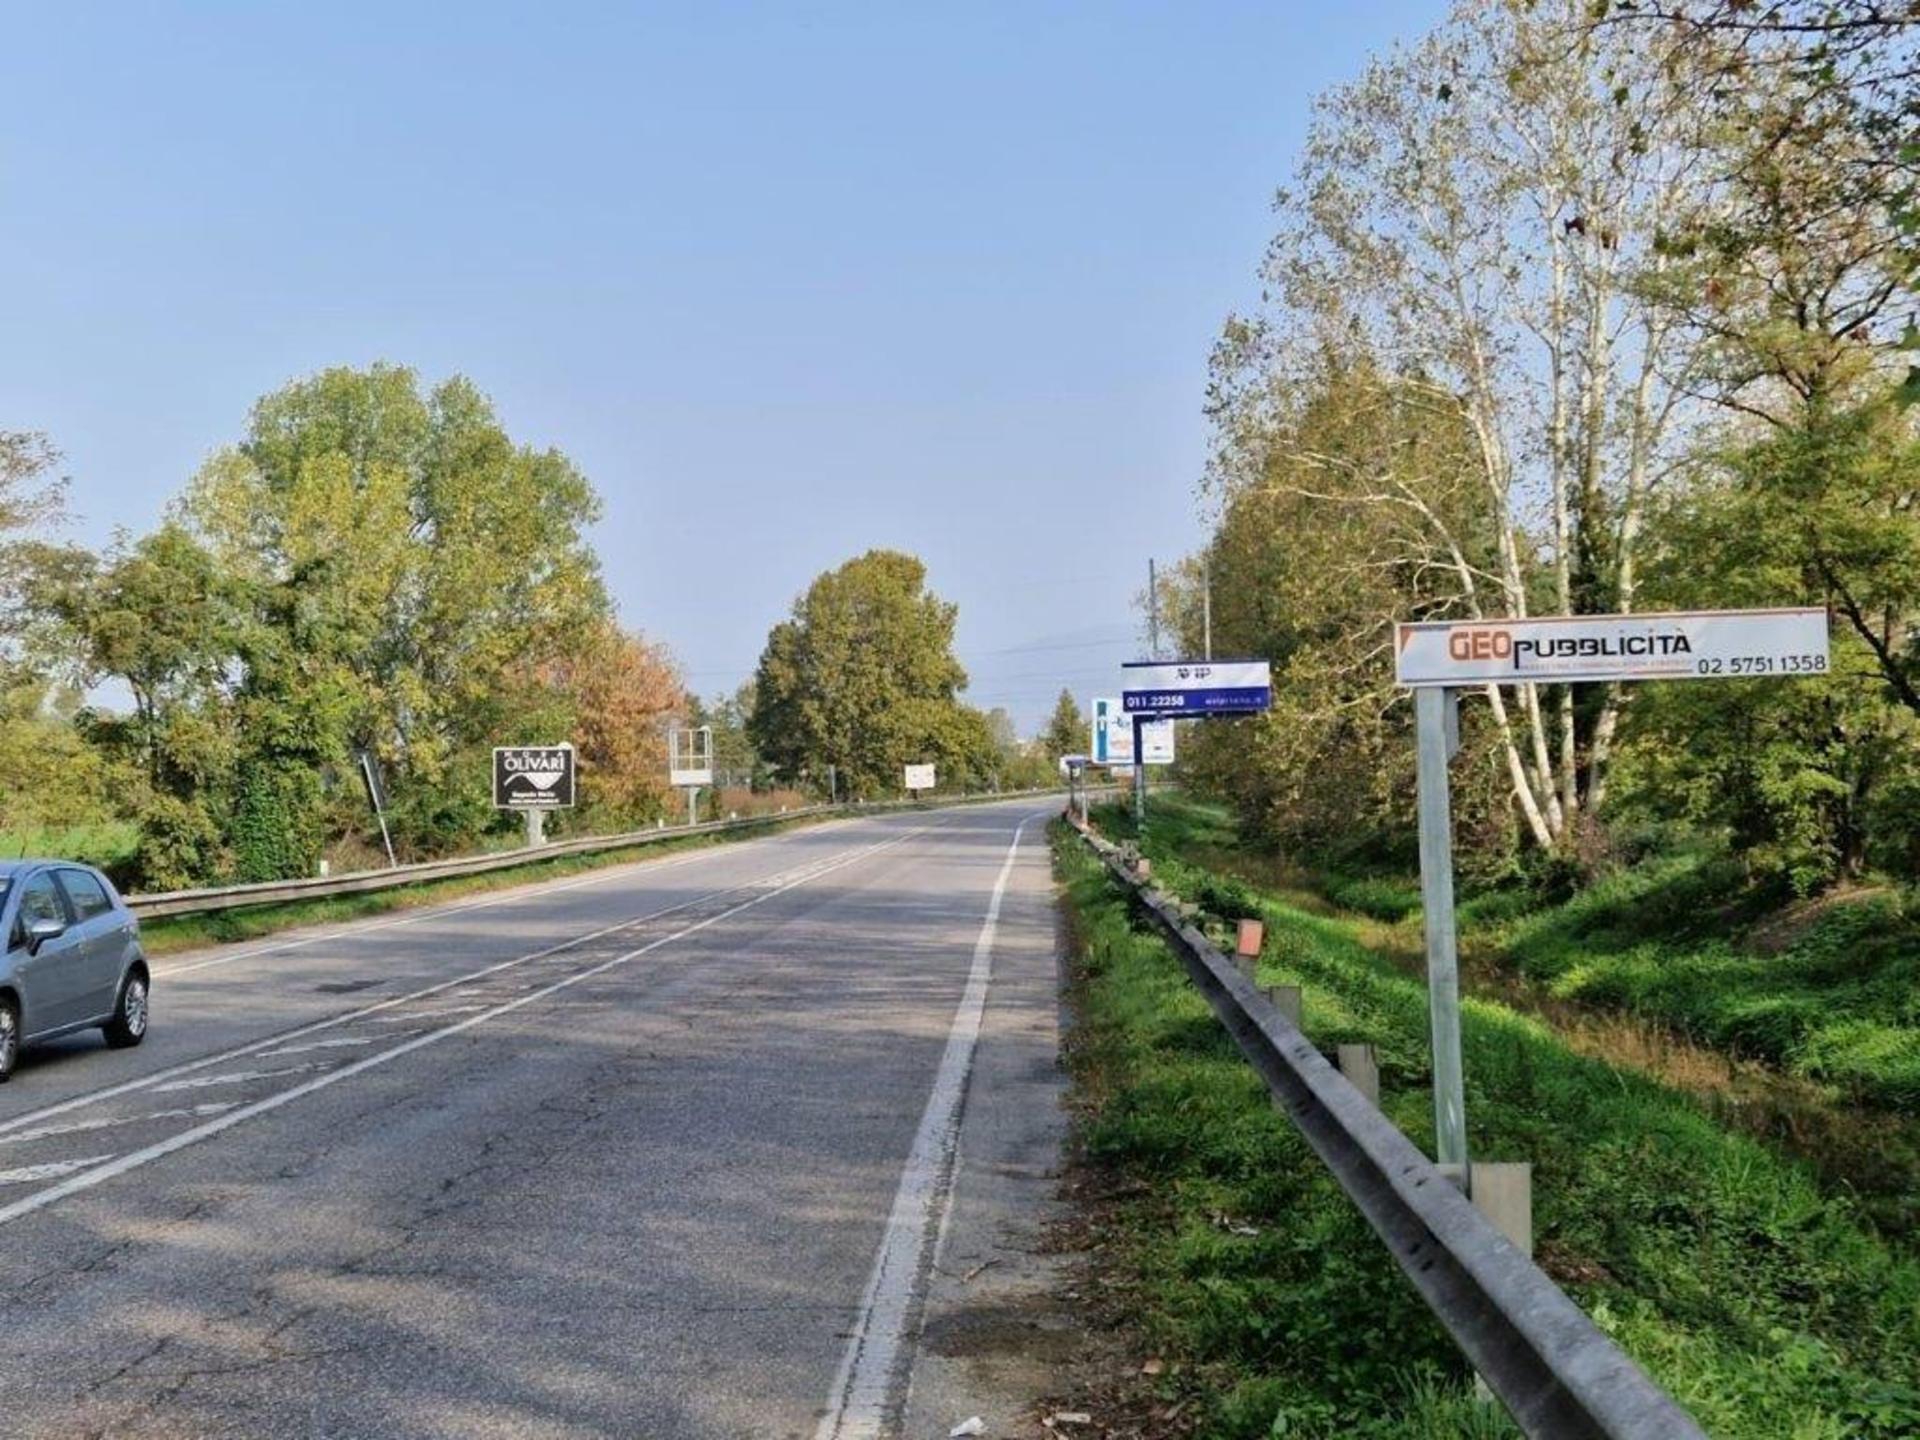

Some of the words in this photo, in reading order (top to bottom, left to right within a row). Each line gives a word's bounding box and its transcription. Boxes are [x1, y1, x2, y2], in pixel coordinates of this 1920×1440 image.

[1698, 659, 1722, 674] 02
[1730, 657, 1773, 673] 5751
[1781, 655, 1826, 671] 1358
[504, 757, 565, 771] OLIVARI
